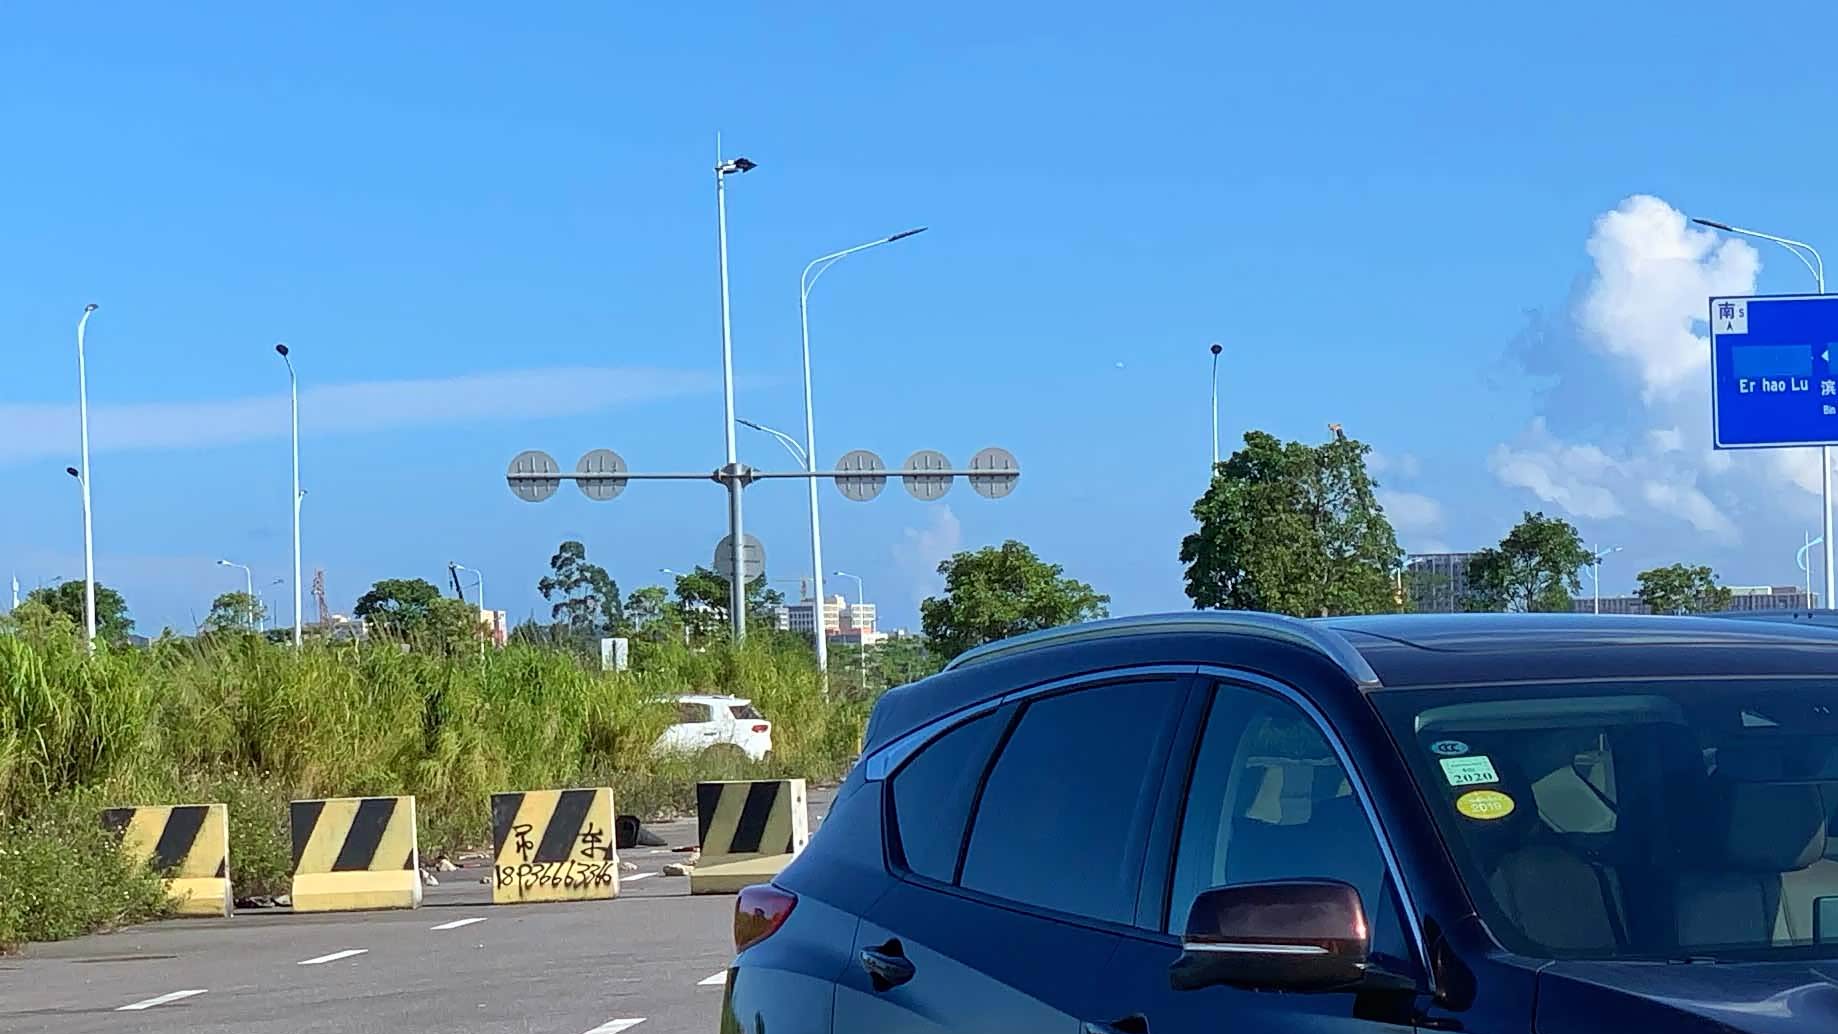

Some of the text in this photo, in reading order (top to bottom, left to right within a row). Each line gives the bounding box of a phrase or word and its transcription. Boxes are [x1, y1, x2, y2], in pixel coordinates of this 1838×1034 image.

[1718, 302, 1735, 320] 南
[1738, 308, 1745, 318] S
[1739, 377, 1809, 393] Er hao Lu
[1453, 771, 1493, 784] 2020
